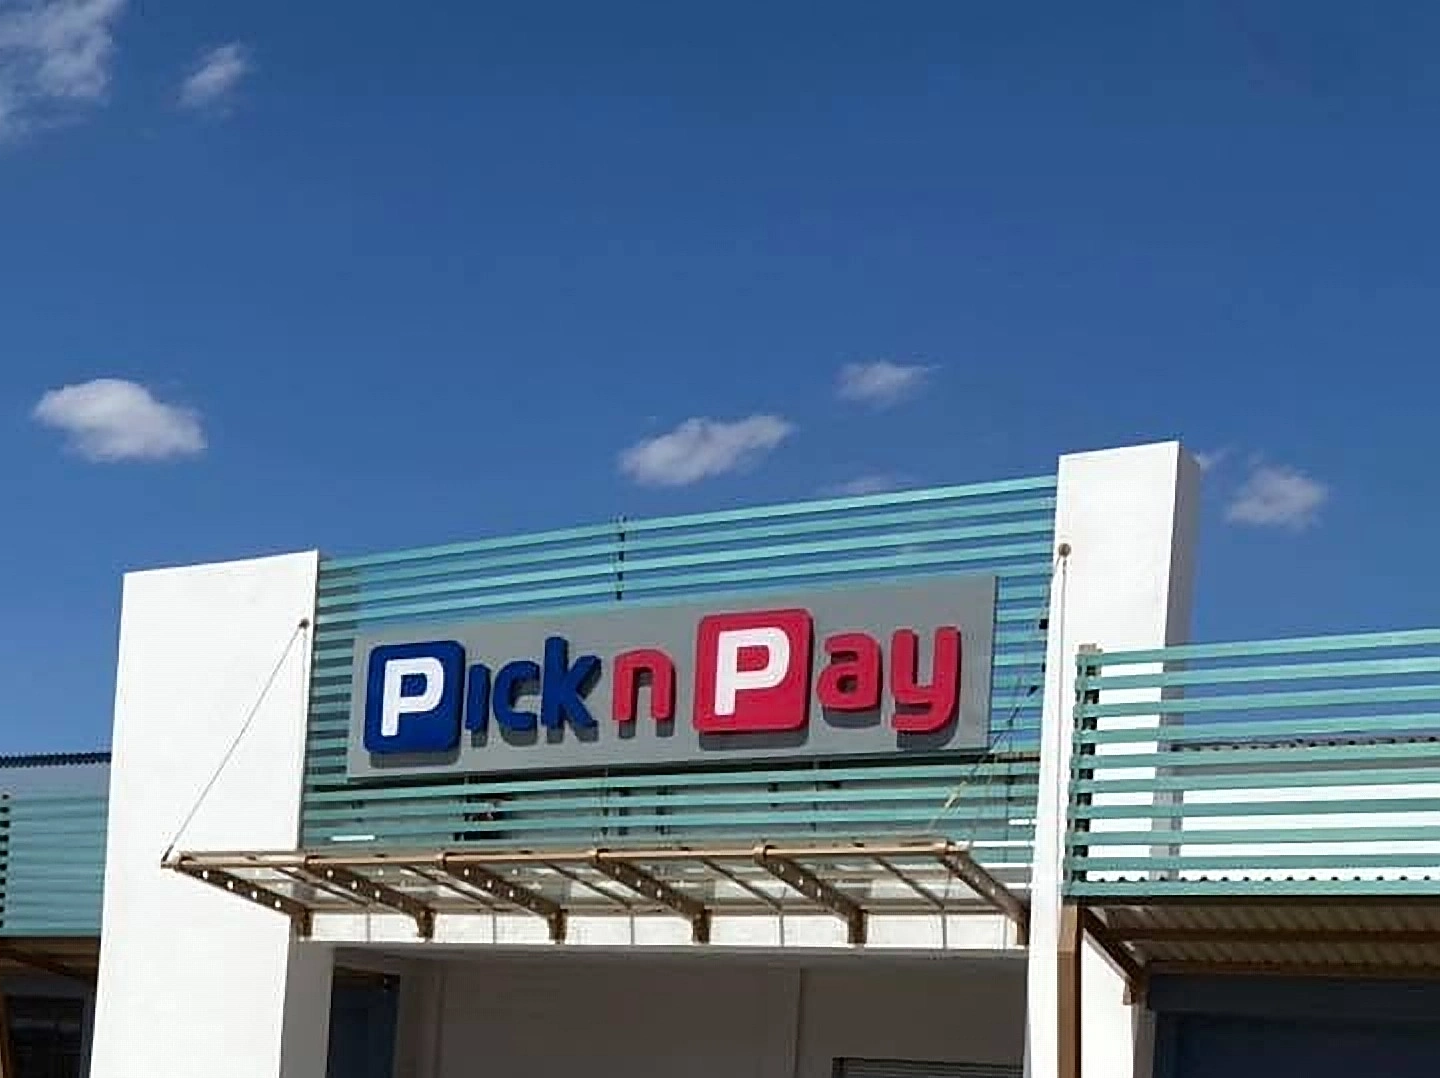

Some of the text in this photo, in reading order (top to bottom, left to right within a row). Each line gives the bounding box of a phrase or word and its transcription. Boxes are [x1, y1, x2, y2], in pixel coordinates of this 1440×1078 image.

[364, 608, 961, 753] Pick n Pay
